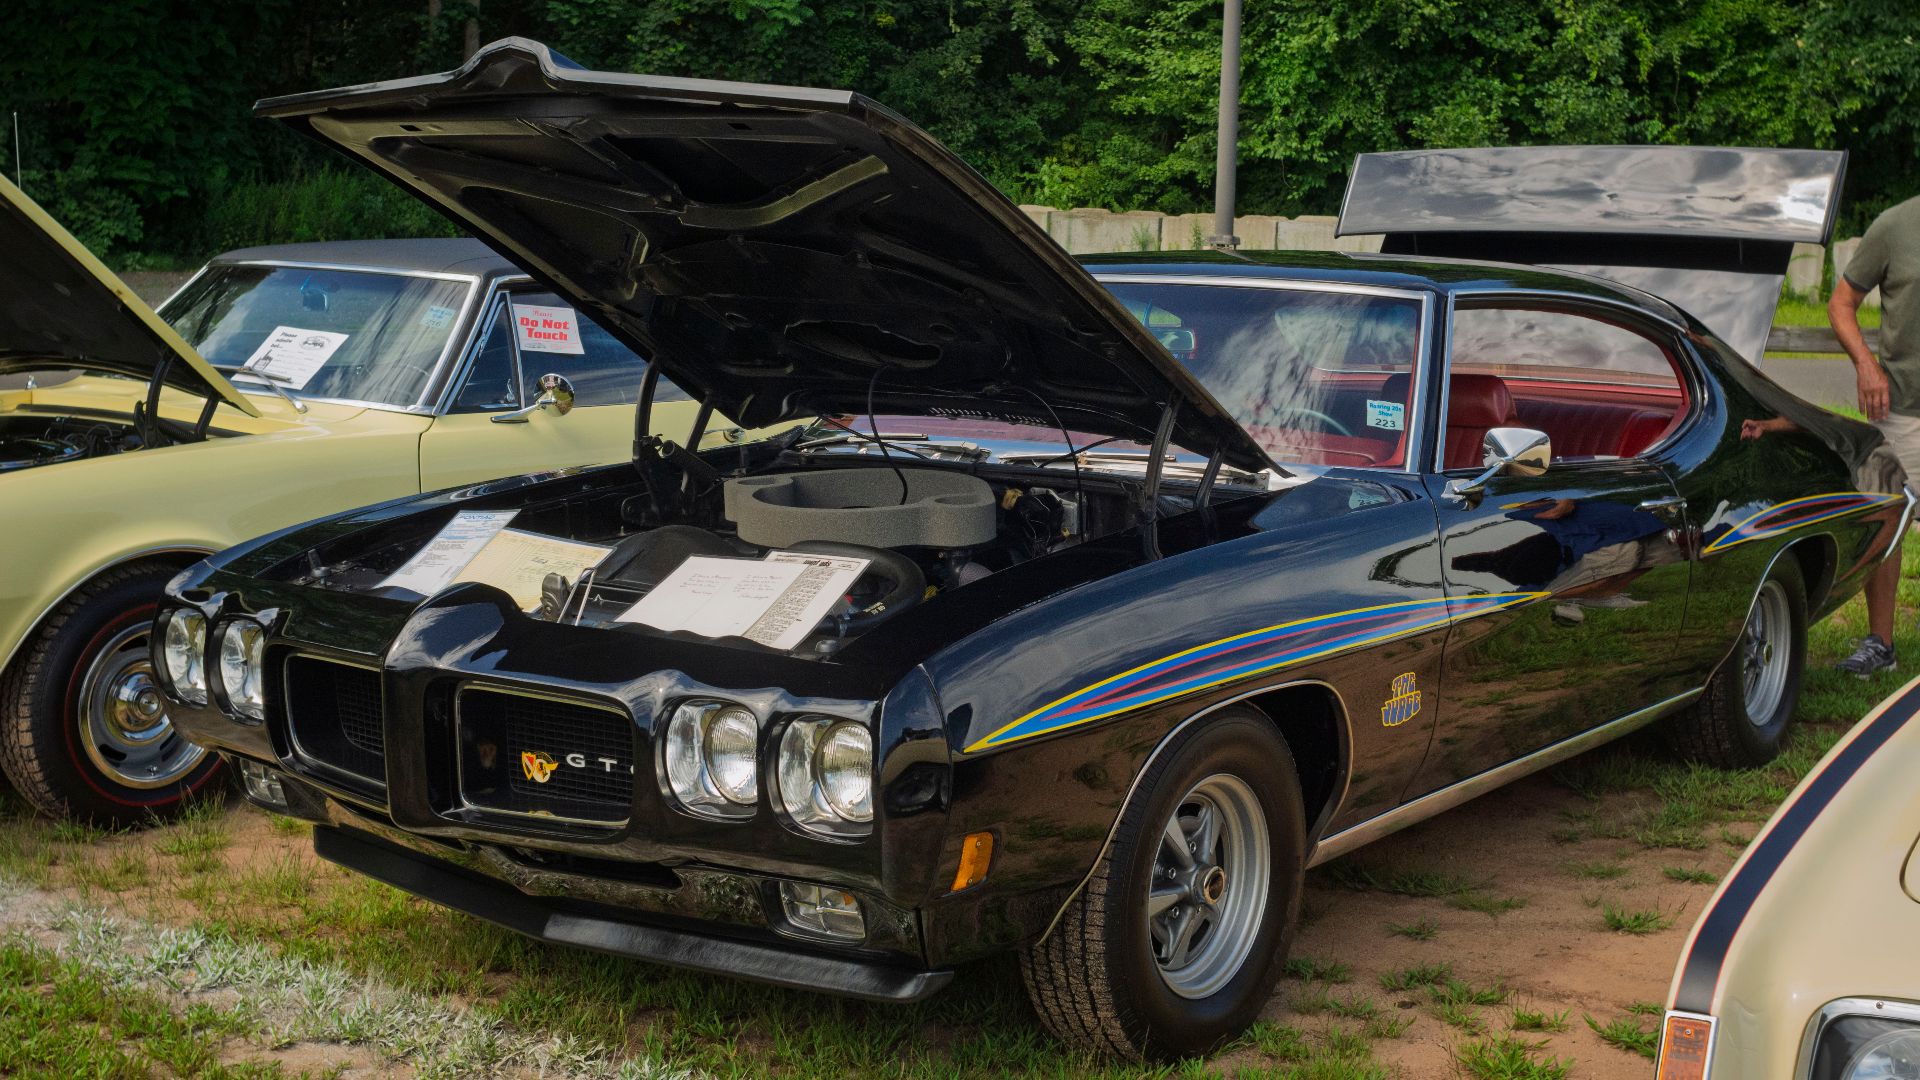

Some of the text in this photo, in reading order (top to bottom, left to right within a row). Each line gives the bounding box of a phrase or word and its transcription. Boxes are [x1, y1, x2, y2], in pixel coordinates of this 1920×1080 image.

[519, 316, 570, 330] Do Not
[526, 327, 568, 341] Touch
[1375, 418, 1396, 428] 223
[1392, 671, 1416, 700] THE
[1381, 690, 1421, 726] JUDGE
[566, 753, 634, 775] GT
